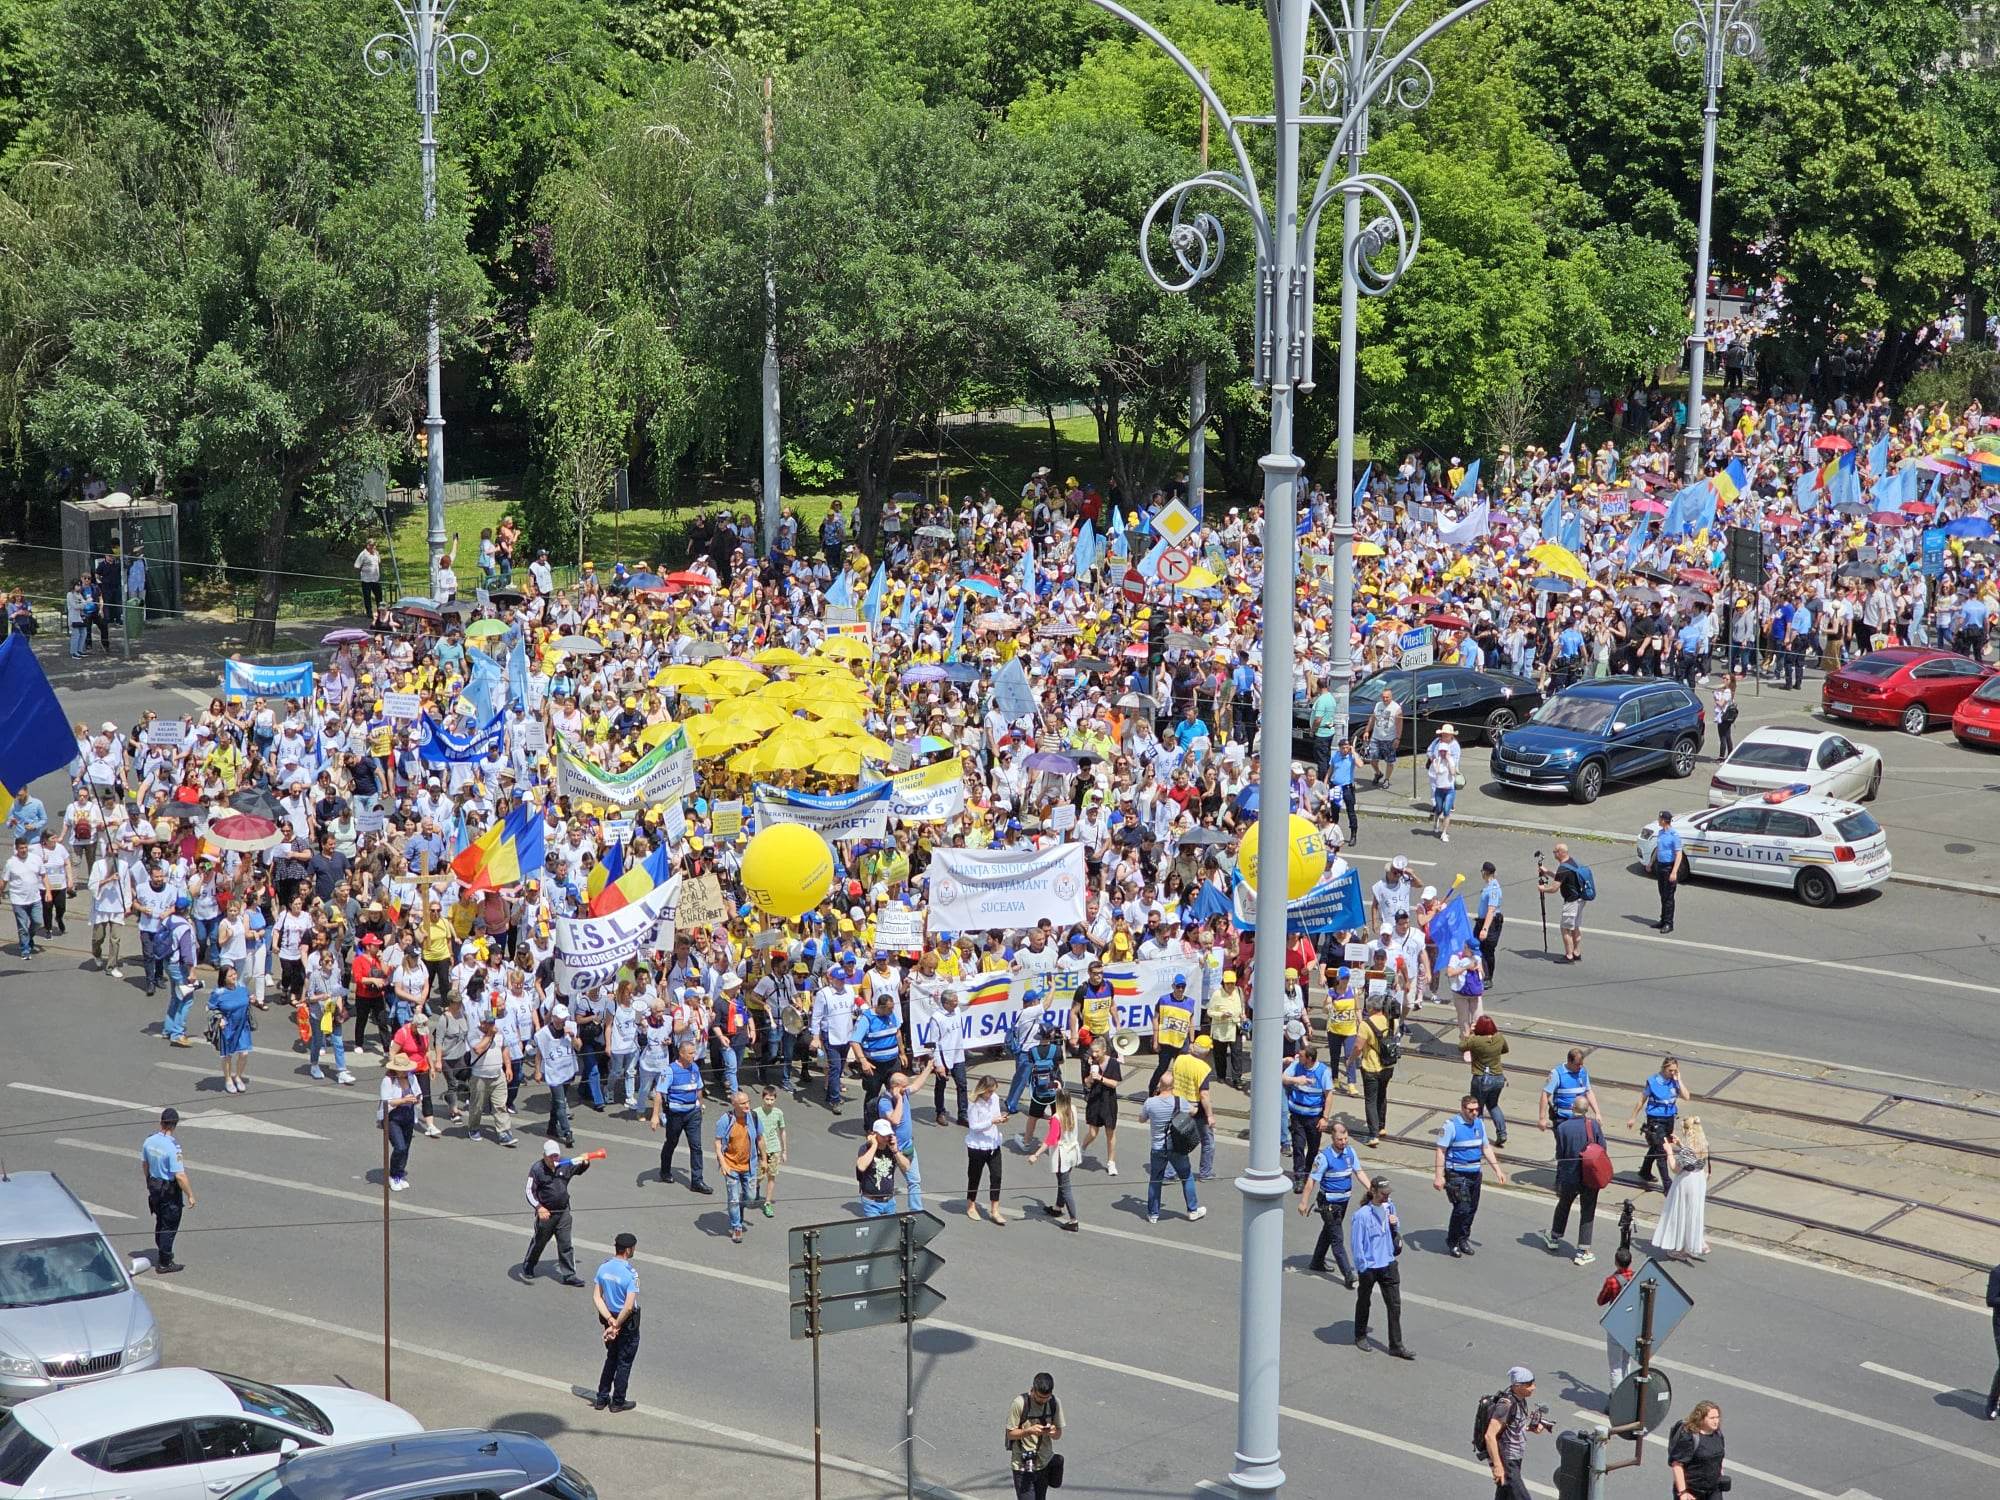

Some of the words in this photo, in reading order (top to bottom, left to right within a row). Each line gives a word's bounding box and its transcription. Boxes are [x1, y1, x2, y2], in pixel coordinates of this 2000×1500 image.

[935, 801, 945, 814] 5
[980, 901, 1026, 913] SUCEAVA
[581, 943, 637, 967] CADRELOR
